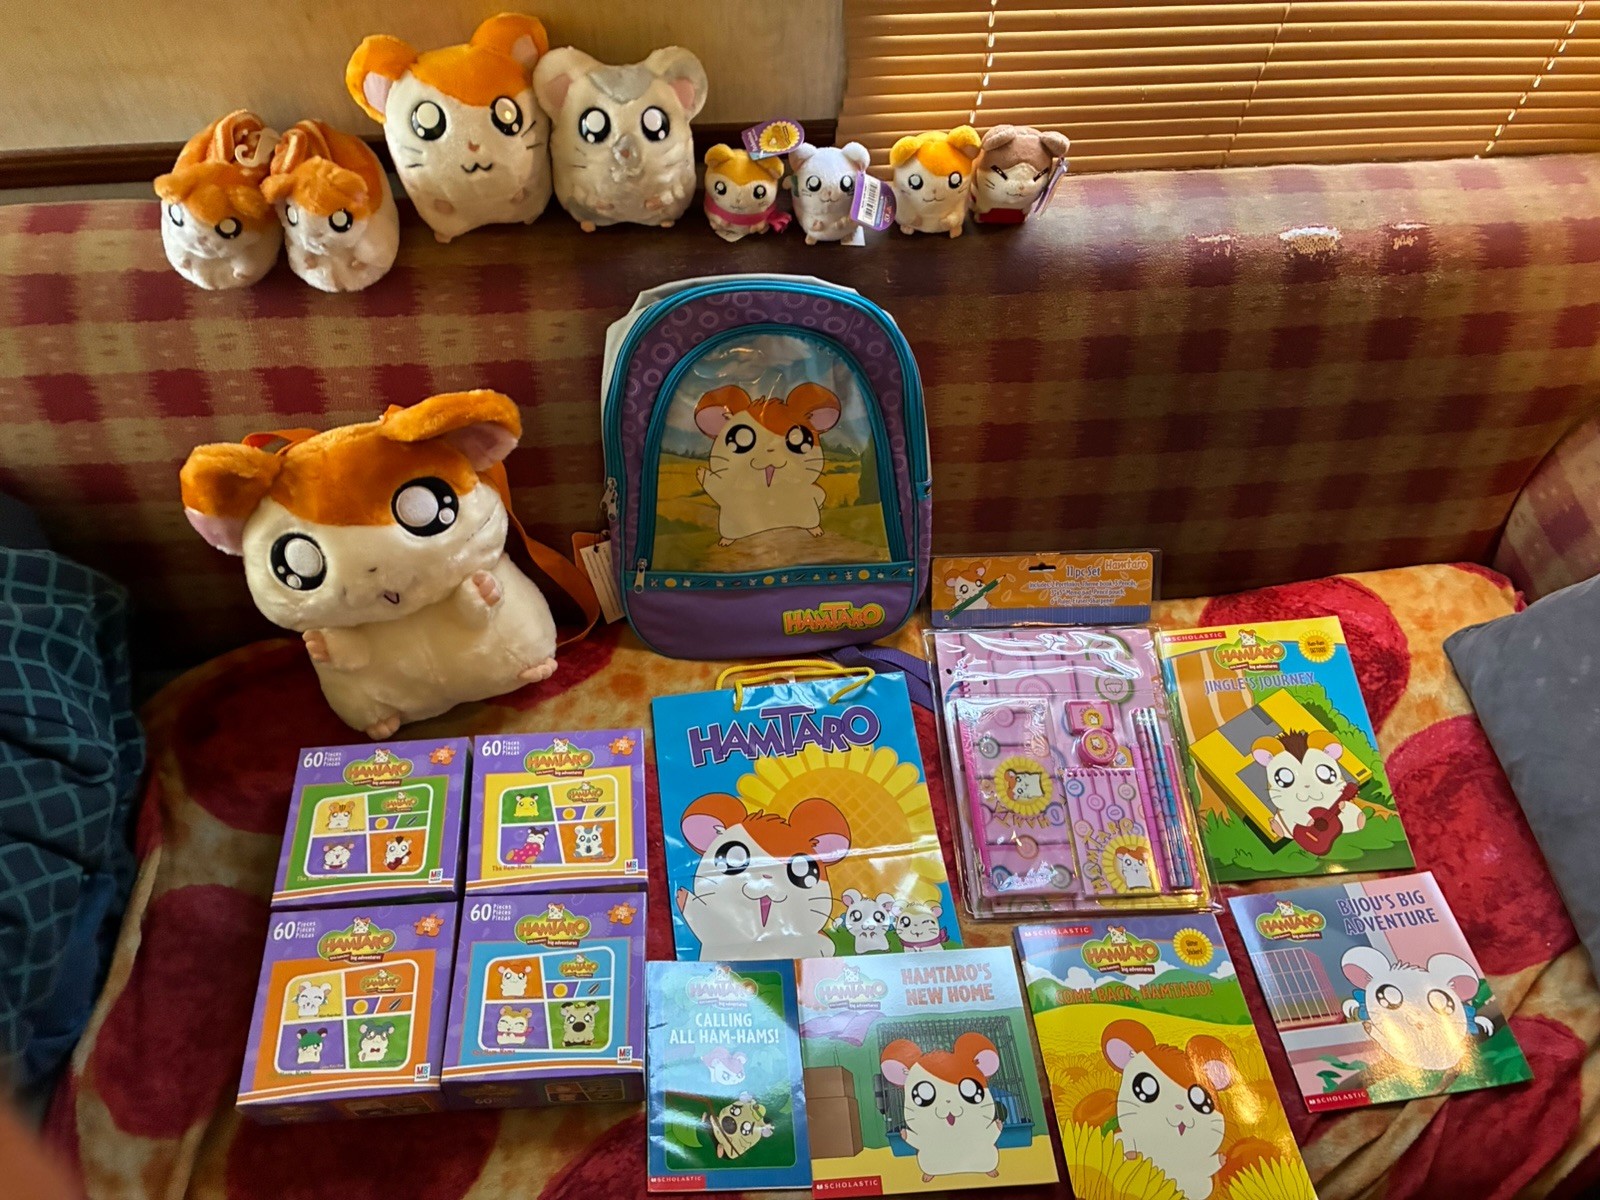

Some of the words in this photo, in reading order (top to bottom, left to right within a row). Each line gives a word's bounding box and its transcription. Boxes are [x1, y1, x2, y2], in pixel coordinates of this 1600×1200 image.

[1087, 565, 1101, 577] Set
[1105, 558, 1148, 571] Hamtaro
[783, 602, 885, 635] HAMTARO
[1171, 632, 1223, 643] SCHOLASTIC
[1218, 643, 1284, 663] HAMTARO
[1204, 675, 1256, 695] JINGLE'S
[1259, 671, 1316, 690] JOURNEY
[687, 704, 881, 767] HAMTARO
[482, 740, 502, 756] 60
[303, 752, 324, 768] 60
[470, 903, 492, 921] 60
[1336, 893, 1396, 918] BIJOU'S
[1397, 889, 1426, 910] BIG
[273, 921, 296, 941] 60
[1032, 926, 1090, 936] SCHOLASTIC
[1259, 913, 1324, 935] HAMTARO
[1343, 907, 1439, 936] ADVENTURE
[1084, 943, 1158, 965] HAMTARO
[901, 962, 992, 985] HAMTARO'S
[817, 979, 886, 1000] HAMTARO
[905, 986, 944, 1006] NEW
[946, 983, 995, 1004] HOME
[1055, 987, 1094, 1005] COME
[1097, 983, 1140, 1004] BACK,
[1139, 980, 1214, 1001] HAMTARO!
[696, 1012, 752, 1027] CALLING
[669, 1030, 695, 1044] ALL
[700, 1028, 780, 1044] HAM-HAMS!
[1316, 1091, 1367, 1104] SCHOLASTIC
[657, 1175, 702, 1183] SCHOLASTIC
[824, 1179, 879, 1190] SCHOLASTIC
